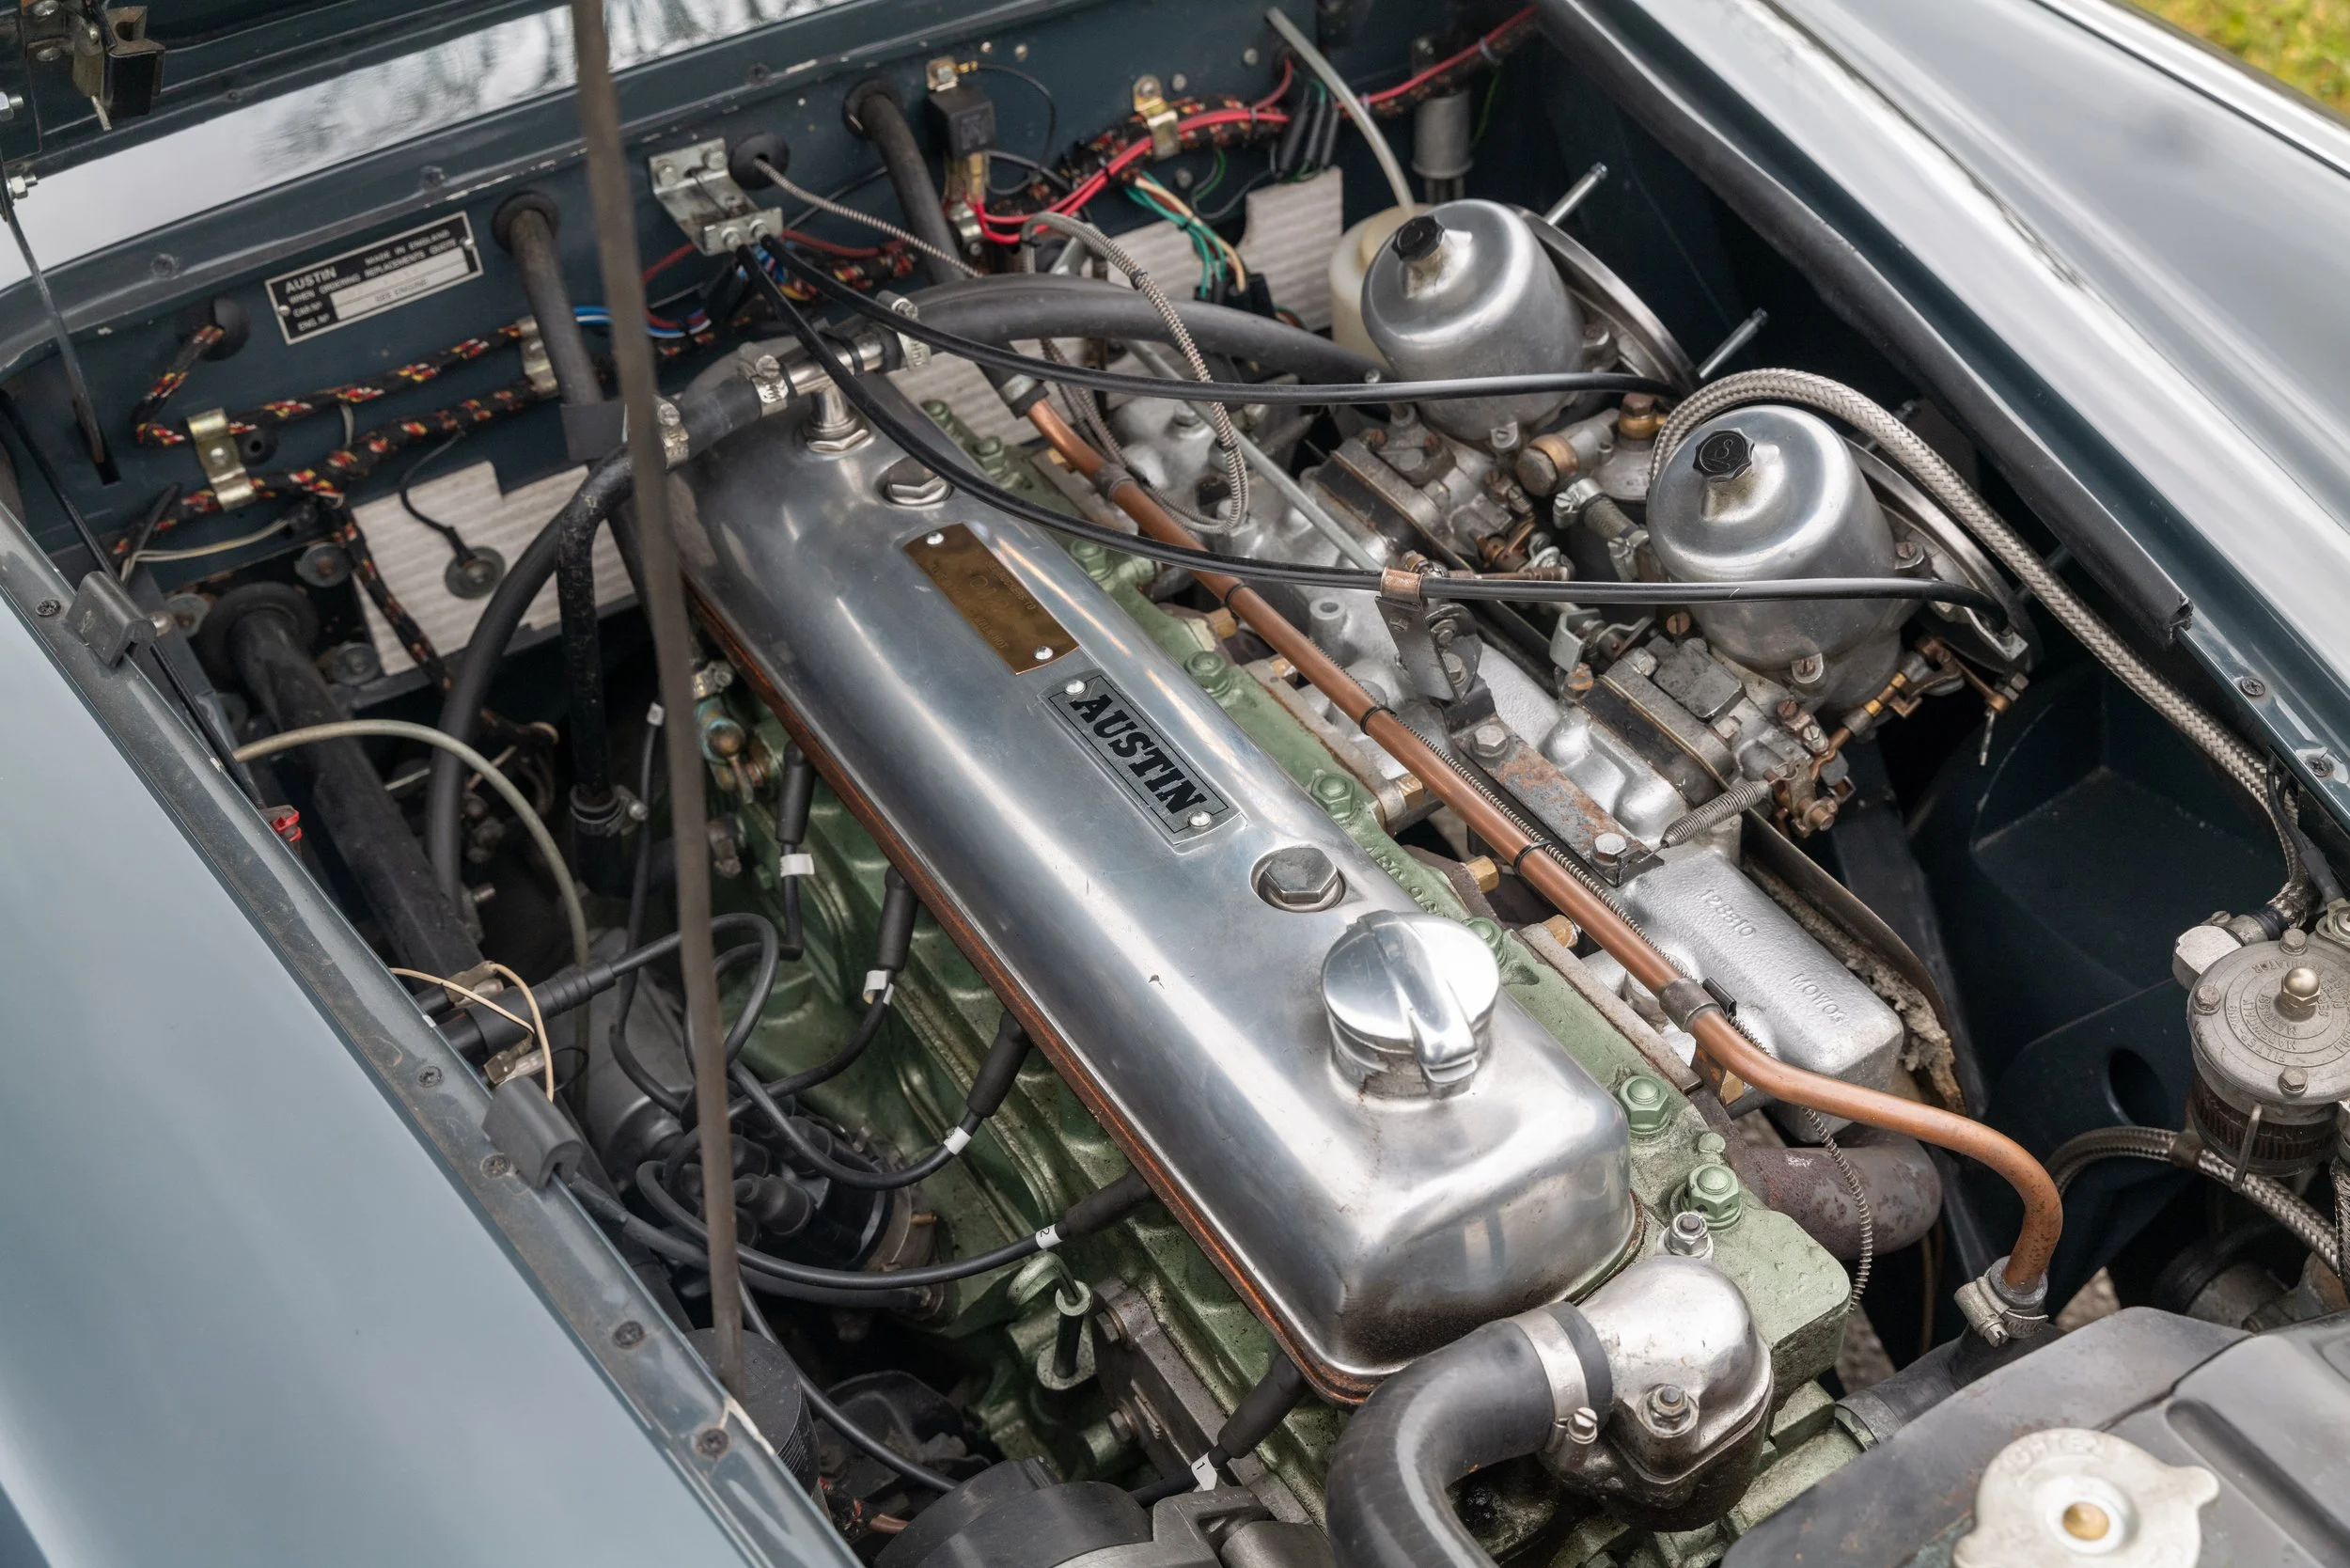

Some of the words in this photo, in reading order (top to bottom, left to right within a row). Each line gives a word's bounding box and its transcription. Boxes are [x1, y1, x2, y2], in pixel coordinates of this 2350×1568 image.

[365, 250, 391, 265] MADE
[408, 229, 450, 250] ENGLAND
[286, 266, 337, 293] AUSTIN
[289, 290, 316, 305] WHEN
[1069, 694, 1208, 815] AUSTIN
[1040, 1228, 1050, 1238] 2
[1196, 1461, 1206, 1470] 1
